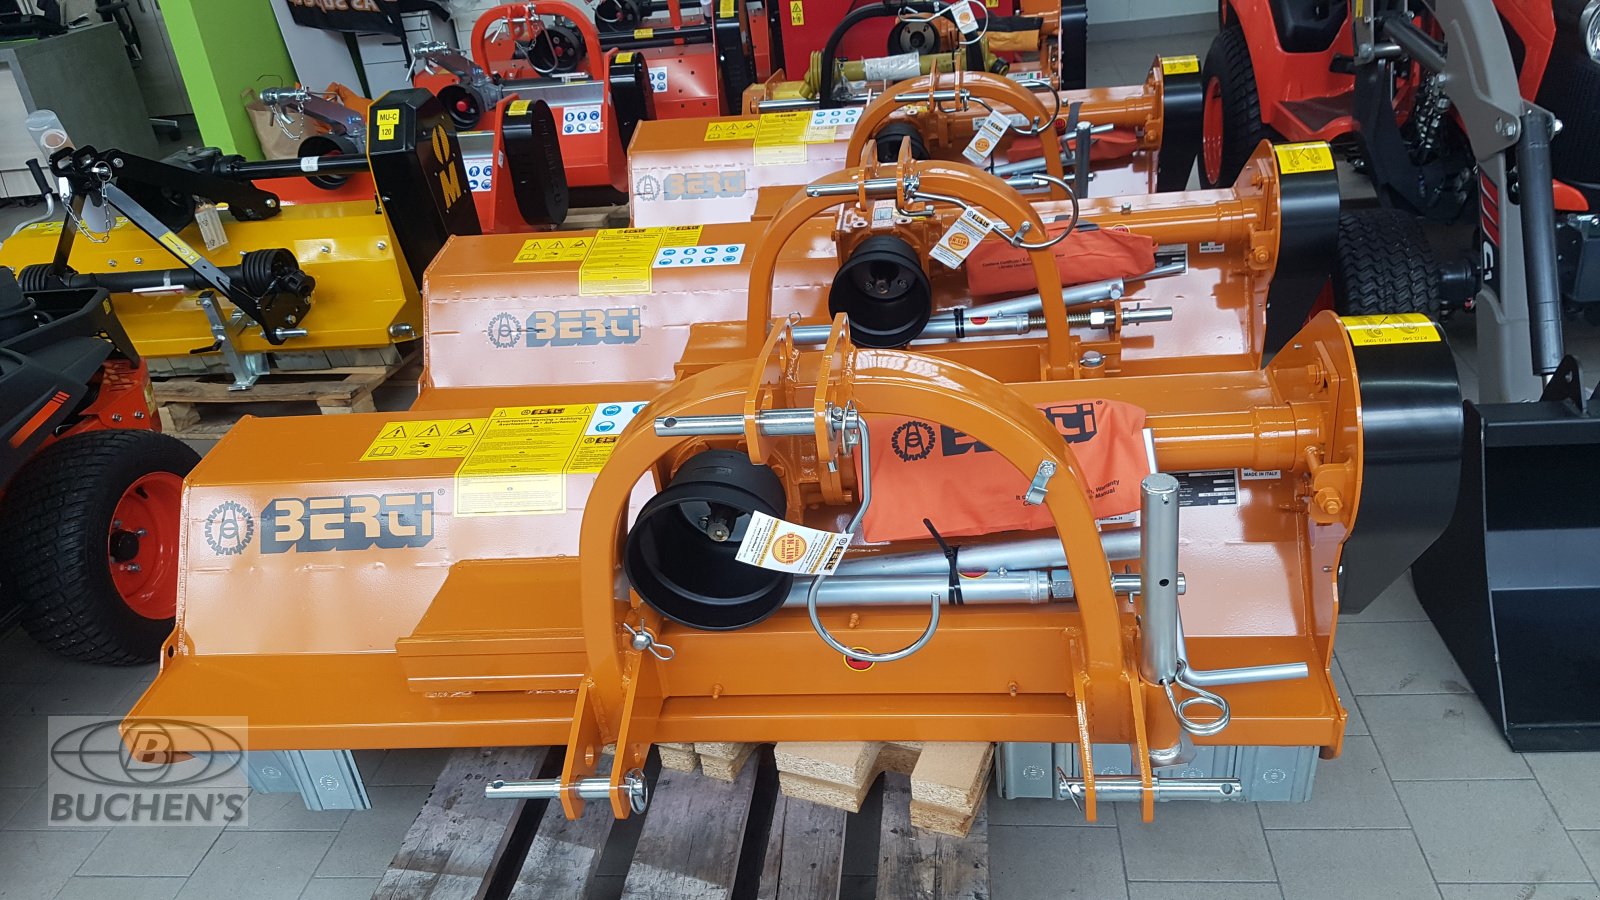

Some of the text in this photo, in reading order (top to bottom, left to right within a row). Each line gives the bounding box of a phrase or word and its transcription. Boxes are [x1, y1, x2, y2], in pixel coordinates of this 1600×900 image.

[380, 114, 397, 122] MU-C
[1095, 488, 1115, 499] Manual
[785, 534, 794, 564] ON-LINE
